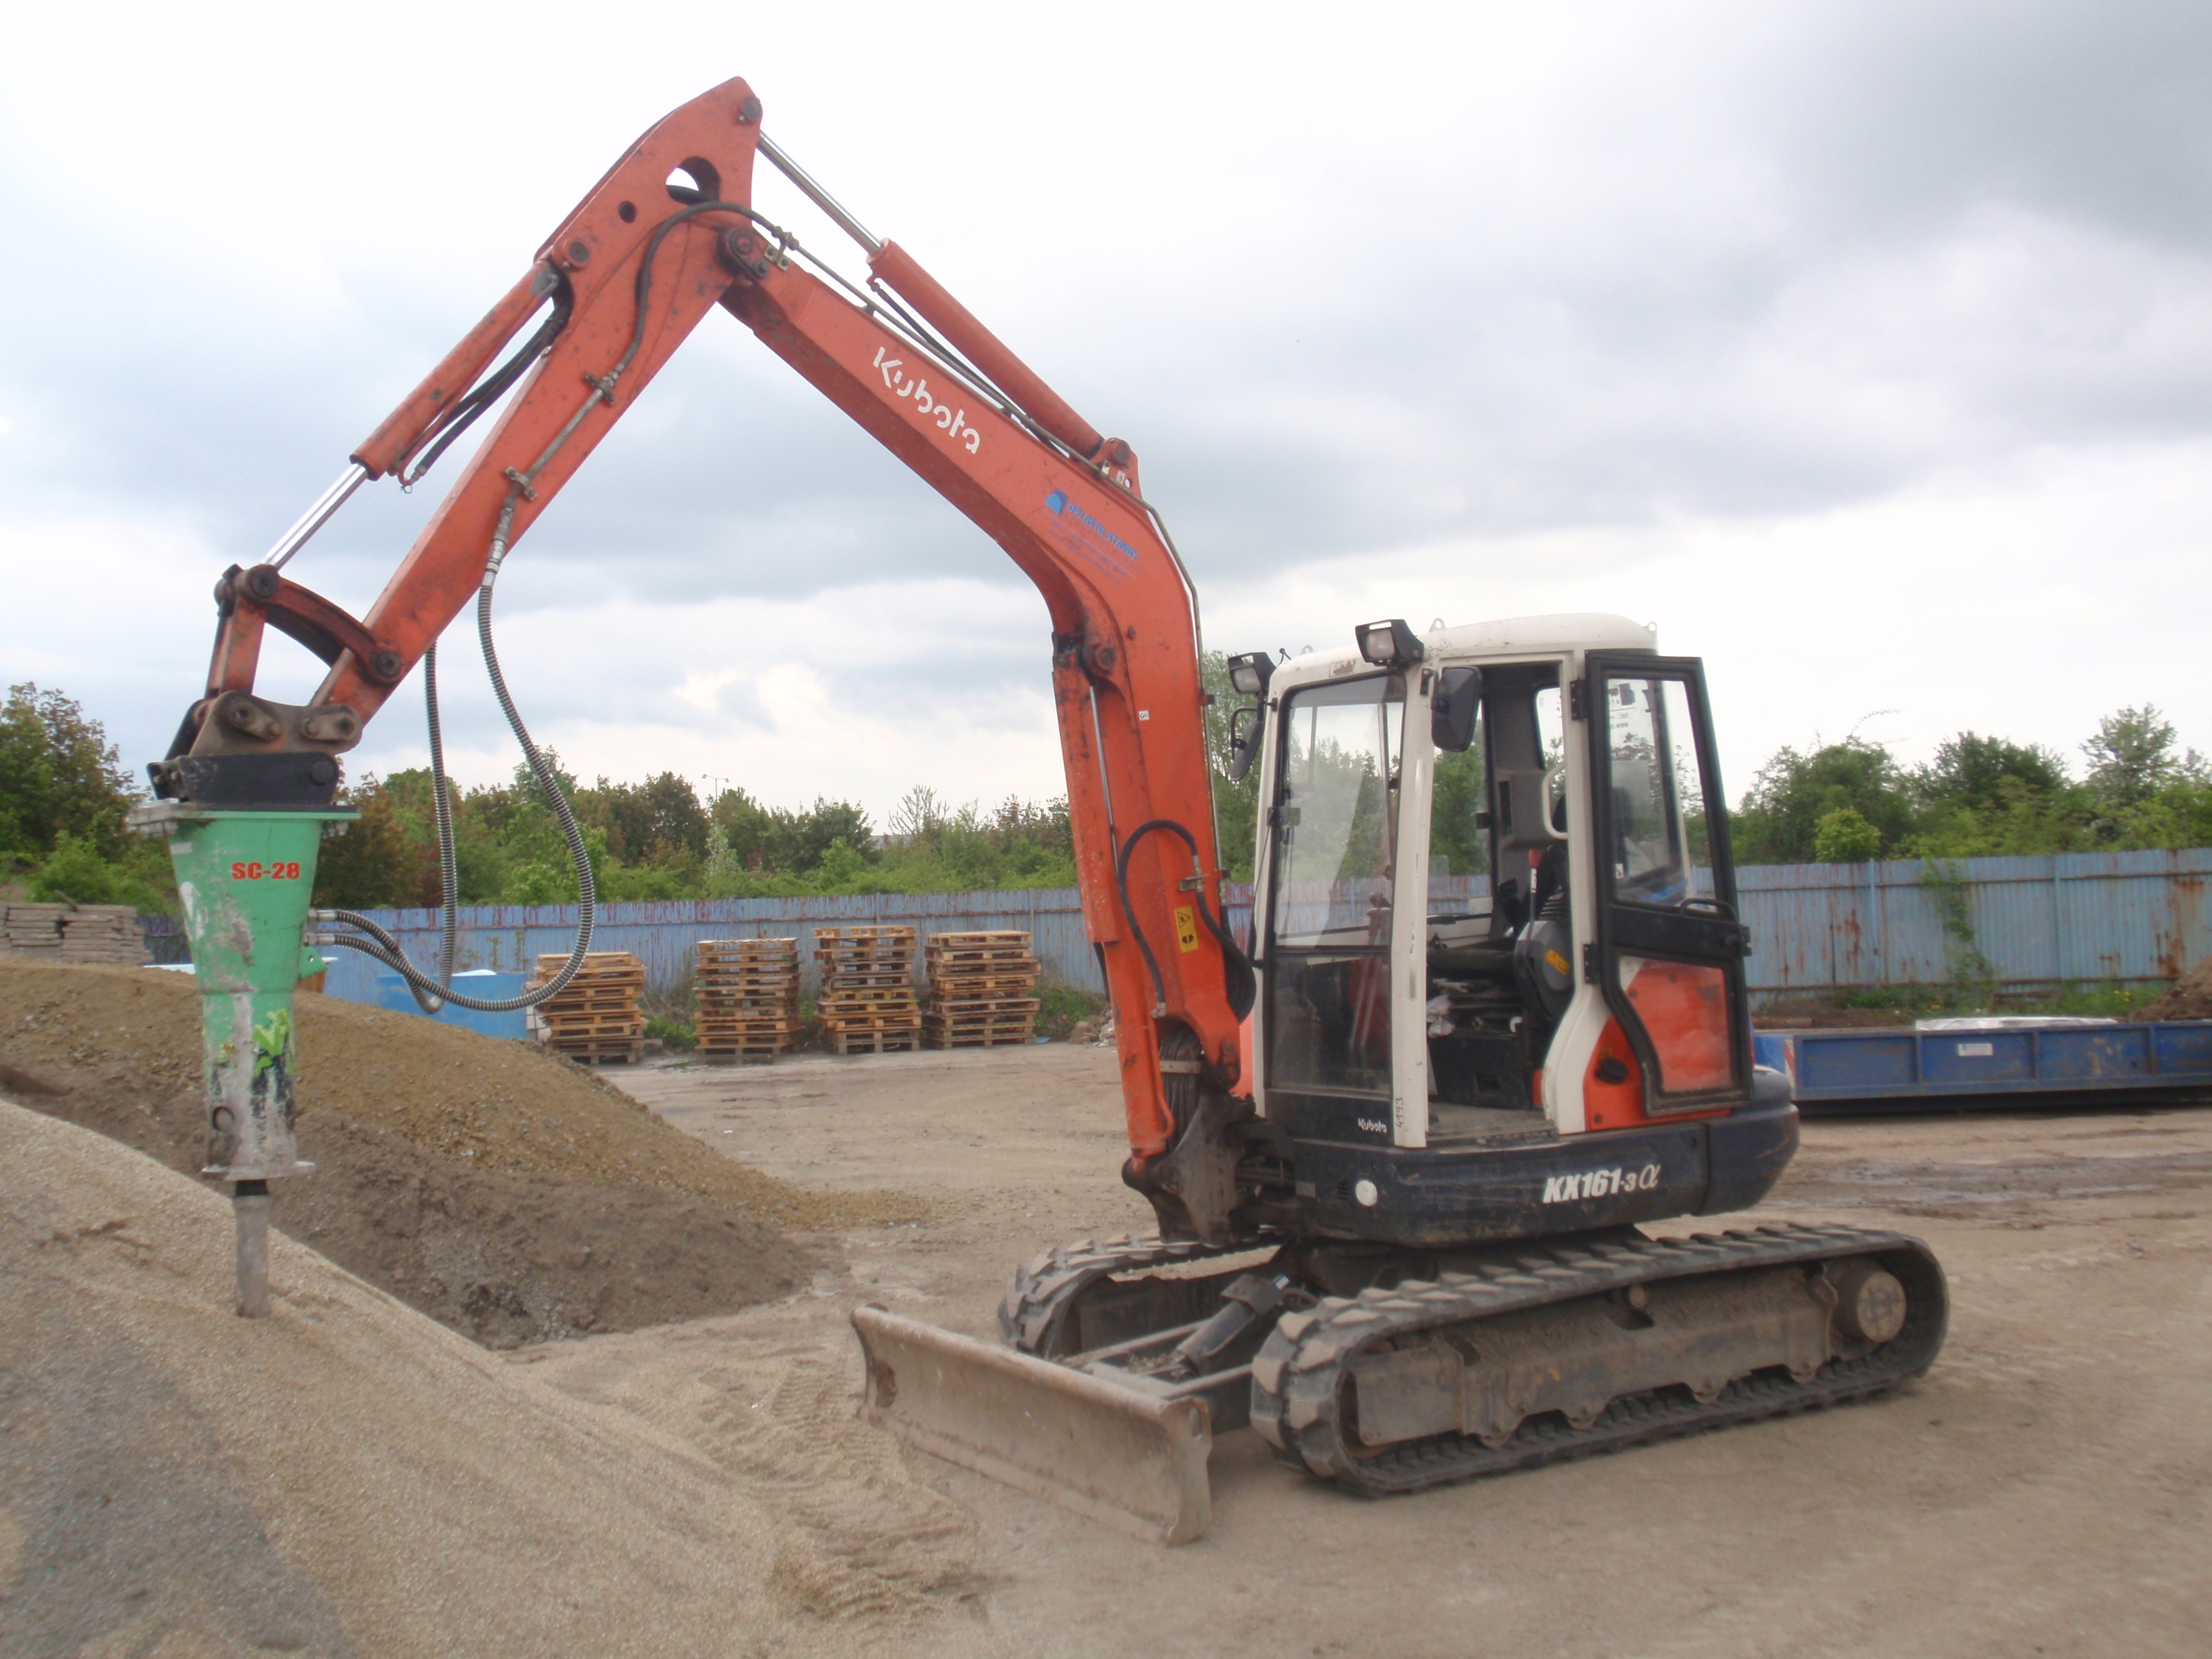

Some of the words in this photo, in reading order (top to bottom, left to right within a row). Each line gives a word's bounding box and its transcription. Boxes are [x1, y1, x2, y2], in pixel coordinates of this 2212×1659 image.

[873, 346, 980, 455] Kubota
[231, 862, 300, 880] SC-28
[1395, 1097, 1404, 1128] 4193
[1358, 1118, 1387, 1133] Kubota
